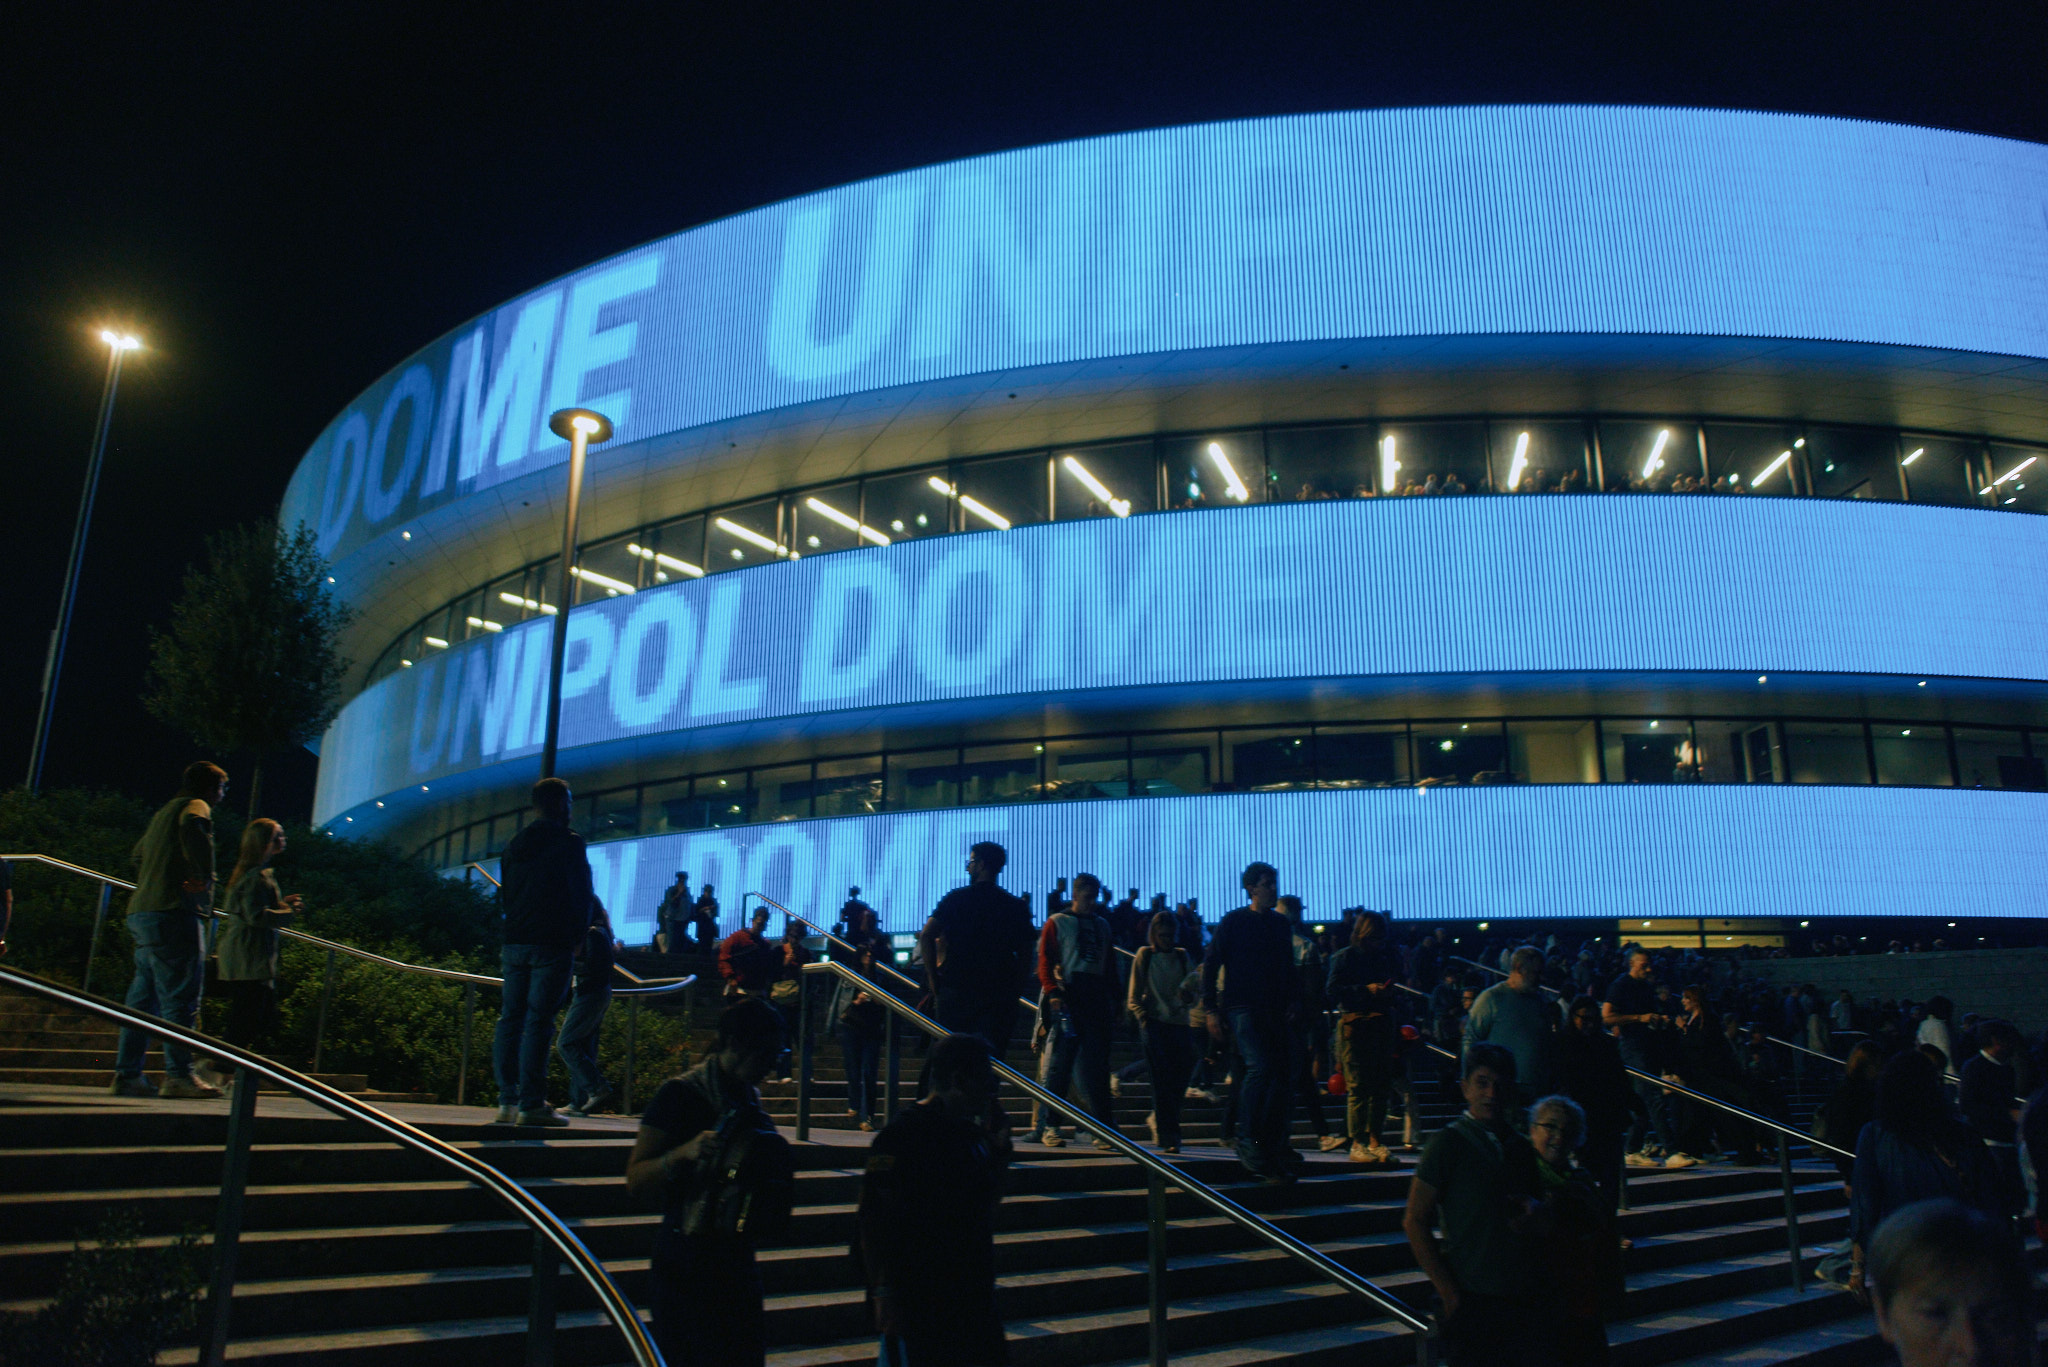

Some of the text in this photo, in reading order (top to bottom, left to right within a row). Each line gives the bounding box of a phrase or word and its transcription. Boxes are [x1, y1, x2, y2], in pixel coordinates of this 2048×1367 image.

[318, 251, 664, 556] DOME
[410, 516, 1320, 773] UNIPOL DOME
